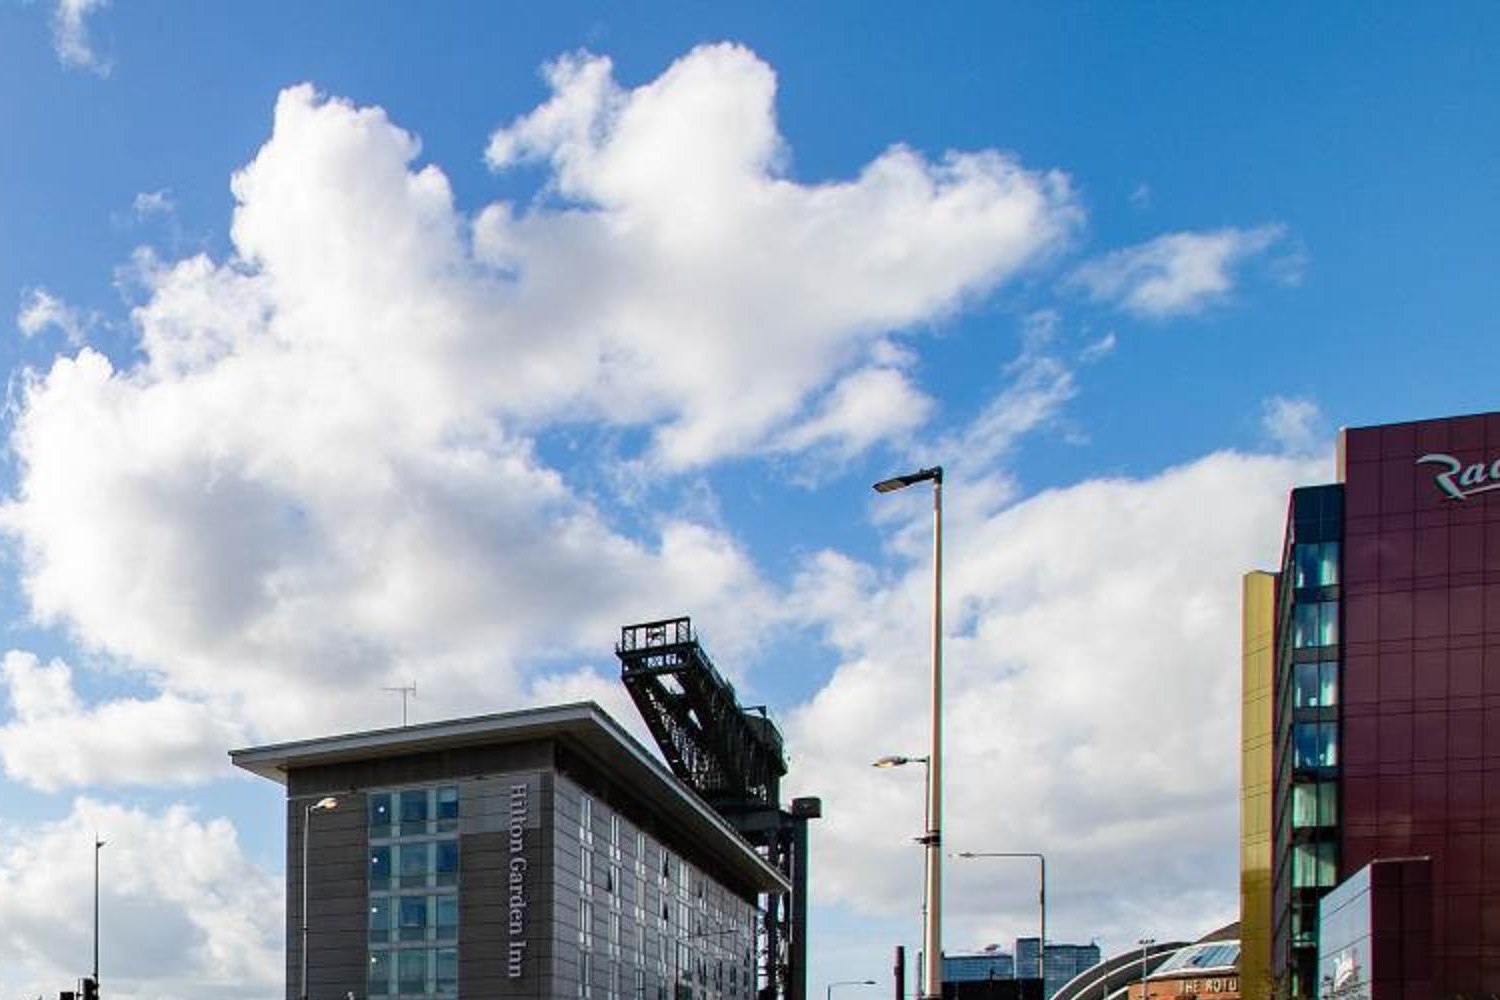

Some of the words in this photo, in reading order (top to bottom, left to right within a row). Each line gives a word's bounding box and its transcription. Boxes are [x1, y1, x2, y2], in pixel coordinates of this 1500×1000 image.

[510, 784, 527, 851] Hilton
[509, 857, 527, 934] Garden
[508, 940, 527, 978] Inn
[1179, 979, 1199, 993] THE
